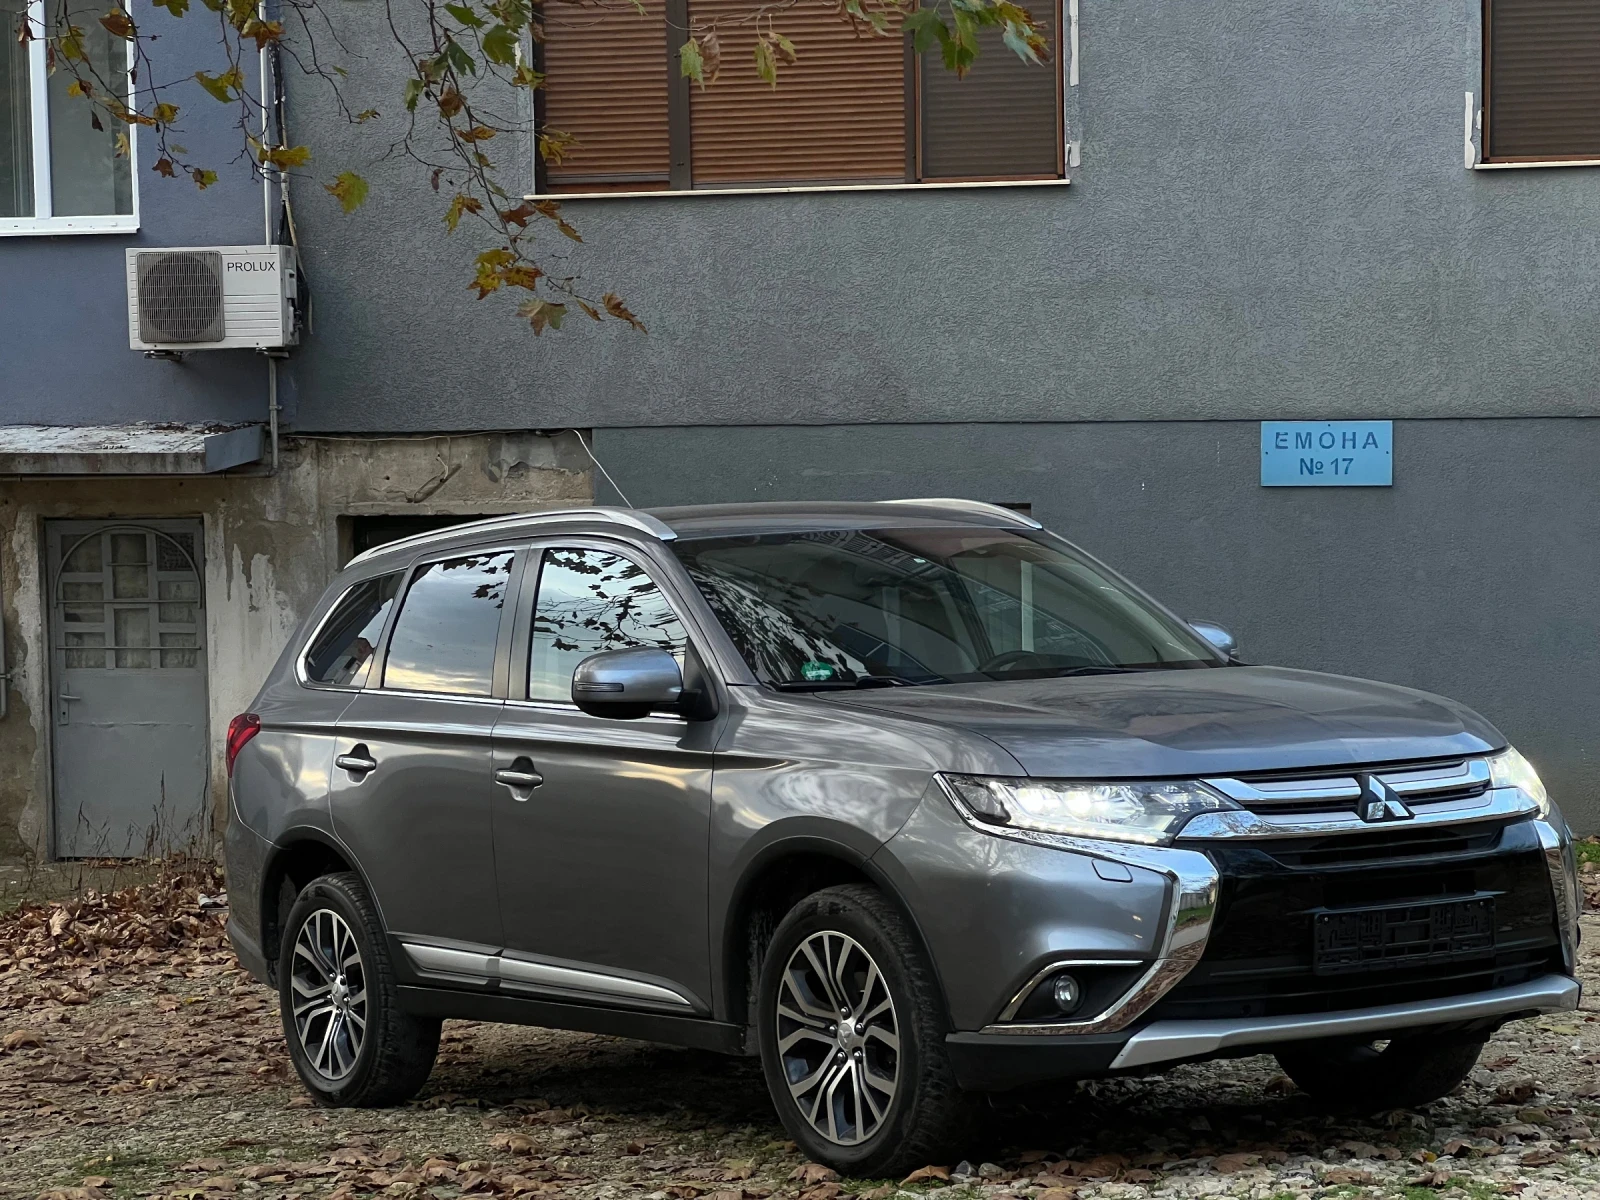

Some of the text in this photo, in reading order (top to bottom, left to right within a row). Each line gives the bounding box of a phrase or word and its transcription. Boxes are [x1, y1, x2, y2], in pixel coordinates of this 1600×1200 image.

[227, 261, 276, 272] PROLUX
[1275, 431, 1379, 450] ЕМОНА
[1330, 457, 1354, 475] 17
